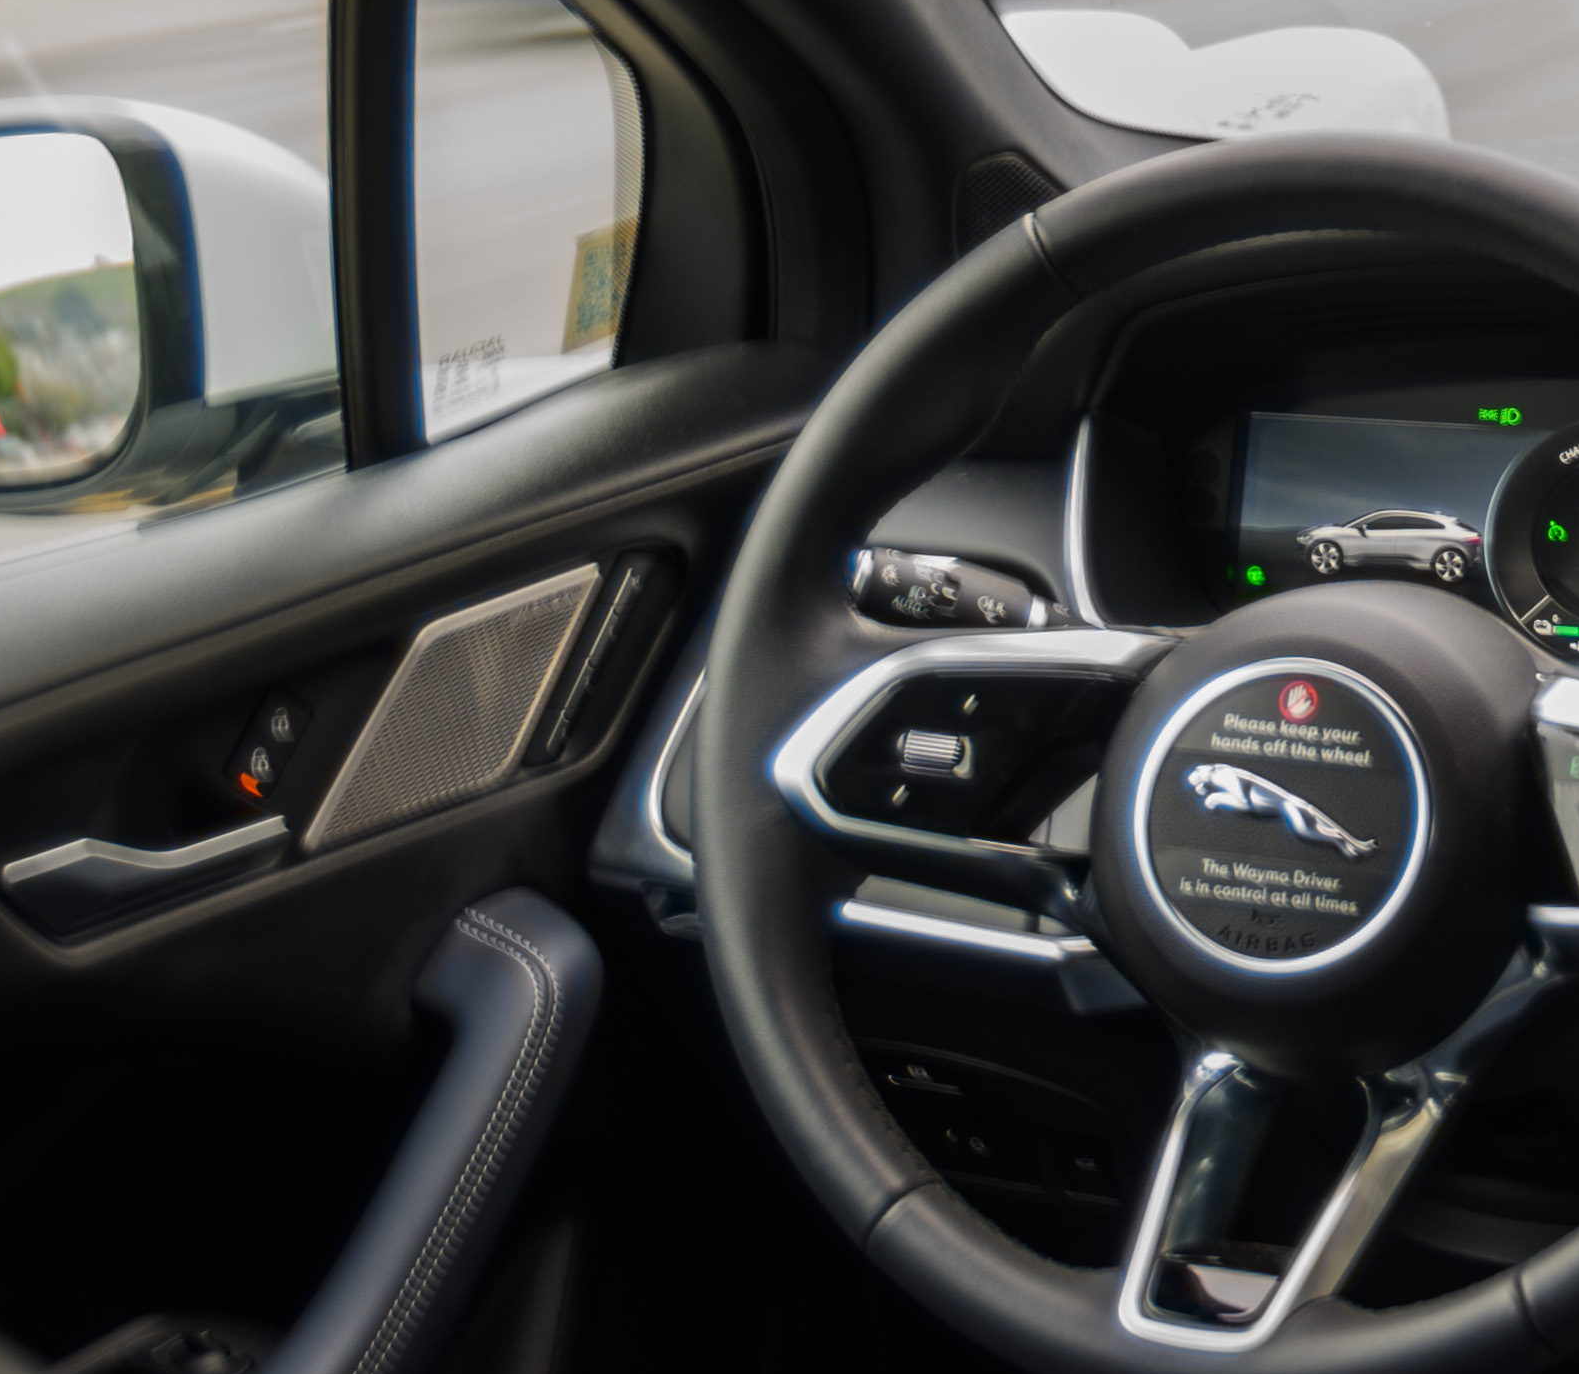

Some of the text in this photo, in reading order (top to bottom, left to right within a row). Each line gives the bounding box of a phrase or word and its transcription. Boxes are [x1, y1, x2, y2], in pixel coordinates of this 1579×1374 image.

[1223, 713, 1362, 744] Please keep your
[1211, 733, 1371, 767] hands off the wheel
[1202, 858, 1342, 891] The Waymo Driver
[1179, 876, 1358, 915] is in control at all times
[1218, 926, 1315, 953] AIRBAG
